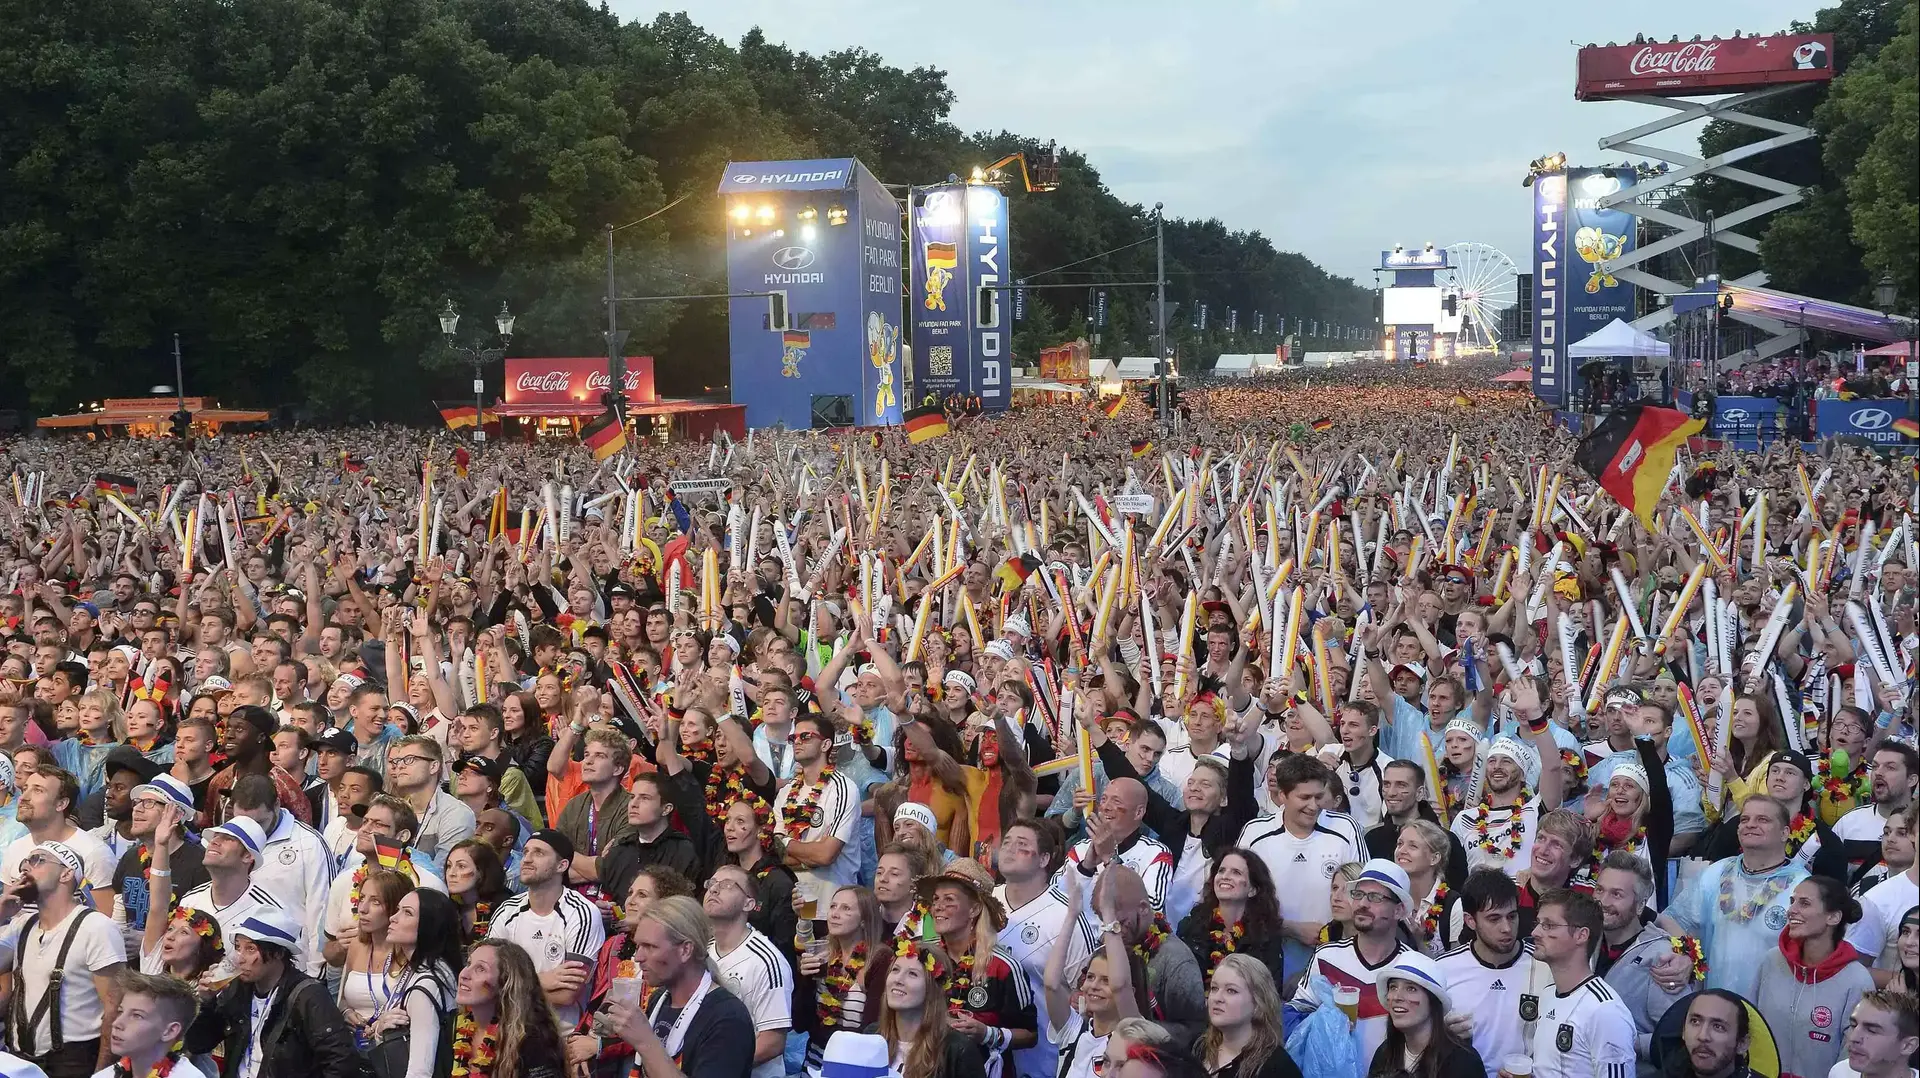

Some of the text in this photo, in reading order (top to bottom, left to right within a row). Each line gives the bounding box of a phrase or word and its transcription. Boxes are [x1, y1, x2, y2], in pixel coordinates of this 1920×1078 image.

[760, 169, 843, 184] HYUNDAI
[865, 217, 895, 240] HYUNDAI
[864, 245, 897, 268] FAN PARK
[764, 272, 824, 284] HYUNDAI
[869, 274, 894, 294] BERLIN
[1540, 204, 1557, 386] HYUNDAI
[517, 371, 572, 391] Coca-Cola
[1567, 642, 1578, 683] HYUNDAI
[1695, 720, 1706, 736] World
[1699, 734, 1710, 746] Cup
[1813, 1032, 1827, 1041] 1977
